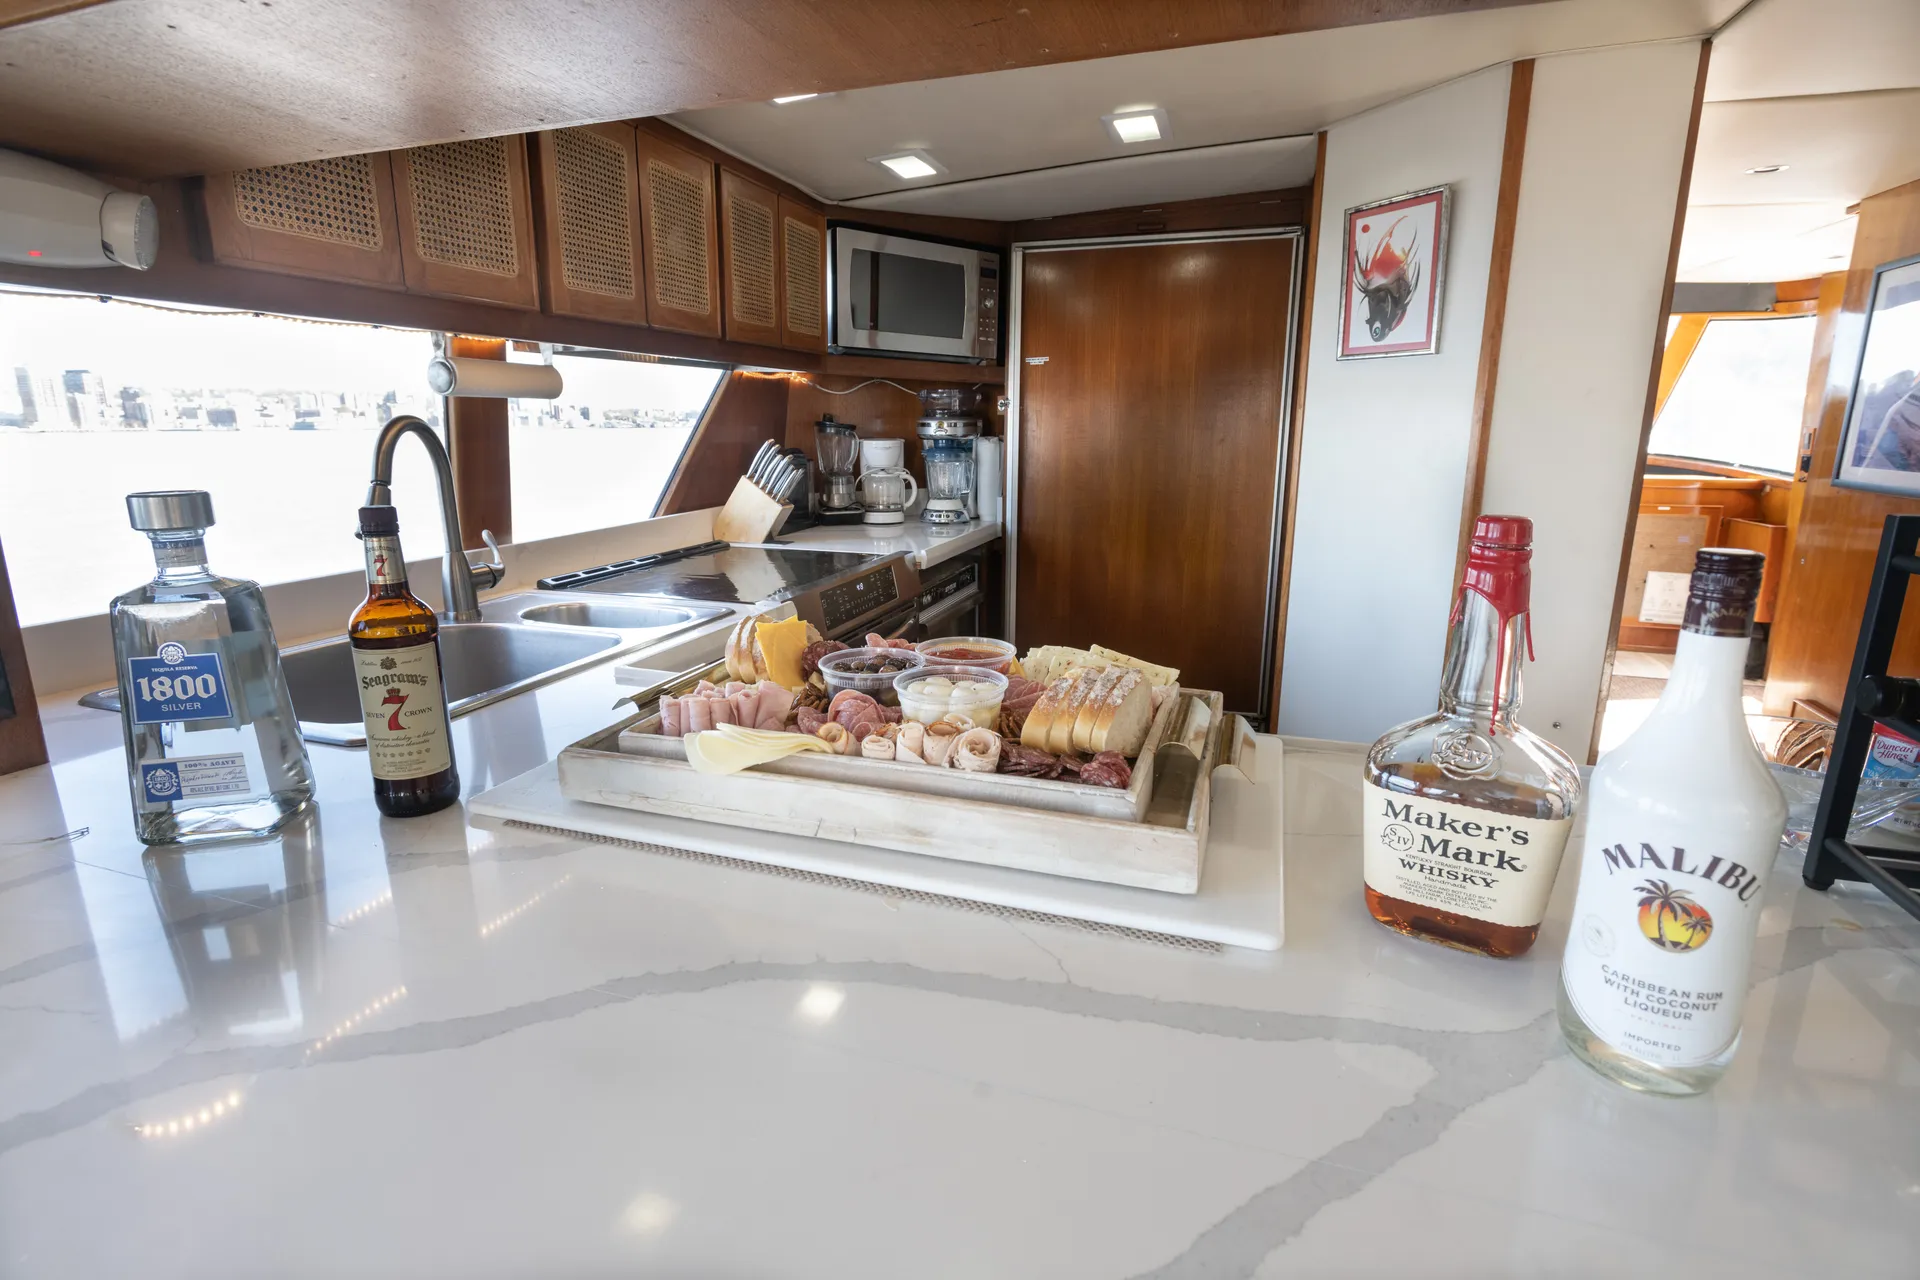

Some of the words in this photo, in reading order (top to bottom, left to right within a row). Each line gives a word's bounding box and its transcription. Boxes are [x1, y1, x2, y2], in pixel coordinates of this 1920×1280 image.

[374, 557, 388, 576] 7
[136, 674, 216, 702] 1800
[362, 672, 428, 690] Seagram's
[161, 702, 202, 712] SILVER
[366, 711, 385, 719] SEVEN
[404, 706, 433, 717] CROWN
[381, 694, 410, 731] 7
[1877, 740, 1914, 753] Duncan
[1877, 750, 1909, 759] Hines
[1382, 798, 1529, 845] Maker's
[1389, 827, 1397, 836] S
[1397, 836, 1410, 846] IV
[1417, 834, 1524, 872] Mark
[1398, 858, 1500, 888] WHISKY
[1405, 854, 1433, 864] KENTUCKY
[1434, 860, 1461, 870] STRAIGHT
[1464, 867, 1492, 877] BOURBON
[1602, 843, 1761, 902] MALIBU
[1424, 876, 1467, 889] Handmade
[1602, 964, 1690, 999] CARIBBEAN
[1697, 992, 1723, 1000] RUM
[1604, 976, 1640, 998] WITH
[1646, 994, 1718, 1011] COCONUT
[1624, 997, 1693, 1020] LIQUEUR
[1624, 1031, 1682, 1052] IMPORTED
